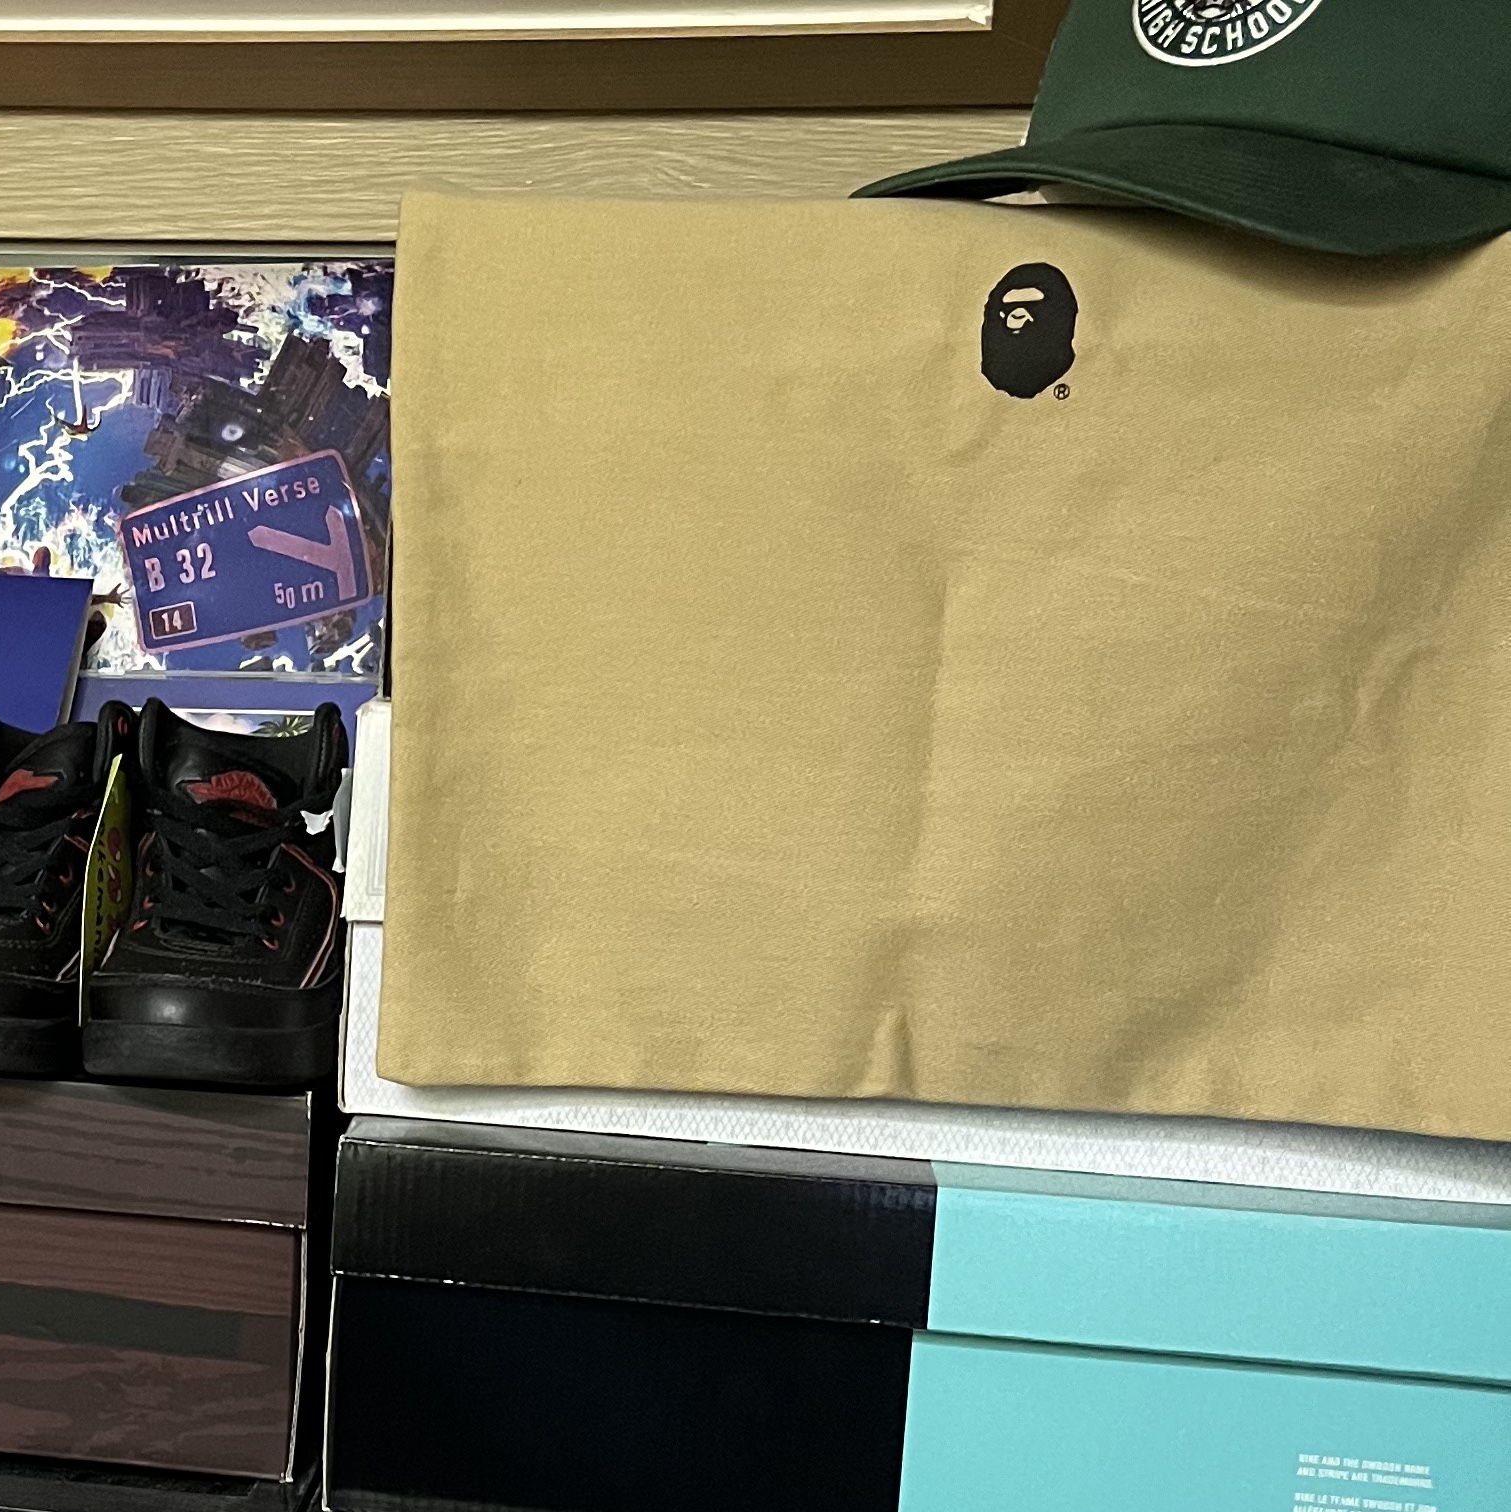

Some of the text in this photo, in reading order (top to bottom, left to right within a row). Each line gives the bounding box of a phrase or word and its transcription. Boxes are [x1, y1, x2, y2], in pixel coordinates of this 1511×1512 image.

[1181, 0, 1305, 55] SCHOO
[131, 477, 321, 548] Multrill Verse
[144, 542, 217, 593] B 32
[301, 580, 325, 603] m
[161, 610, 183, 633] 14
